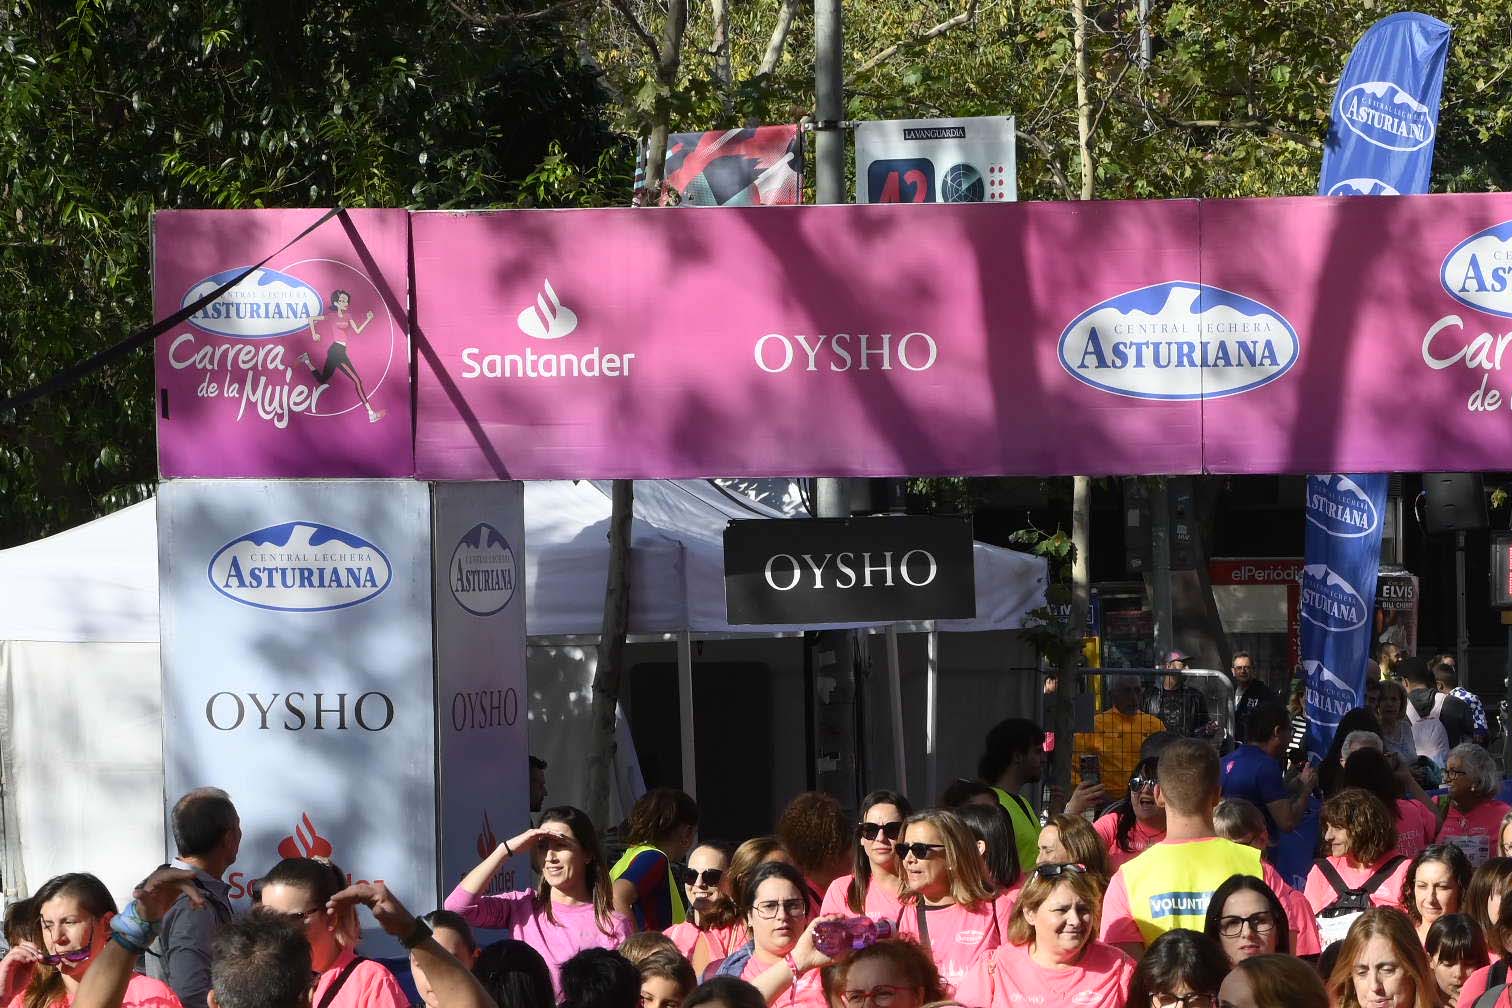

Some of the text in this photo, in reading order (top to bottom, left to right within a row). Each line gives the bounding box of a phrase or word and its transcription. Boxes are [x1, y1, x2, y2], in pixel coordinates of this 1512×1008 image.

[192, 293, 312, 320] ASTURIANA
[1114, 321, 1271, 335] CENTRAL LECHERA
[169, 333, 287, 370] Carrera
[462, 346, 634, 378] Santander
[754, 332, 937, 373] OYSHO
[1077, 326, 1280, 369] ASTURIANA
[198, 369, 329, 429] de la Mujer
[1468, 374, 1502, 412] de
[223, 555, 378, 589] ASTURIANA
[250, 553, 372, 562] CENTRAL LECHERA
[455, 557, 512, 593] ASTURIANA
[764, 550, 937, 591] OYSHO
[1382, 585, 1413, 598] ELVIS
[205, 691, 394, 732] OYSHO
[452, 687, 518, 731] OYSHO
